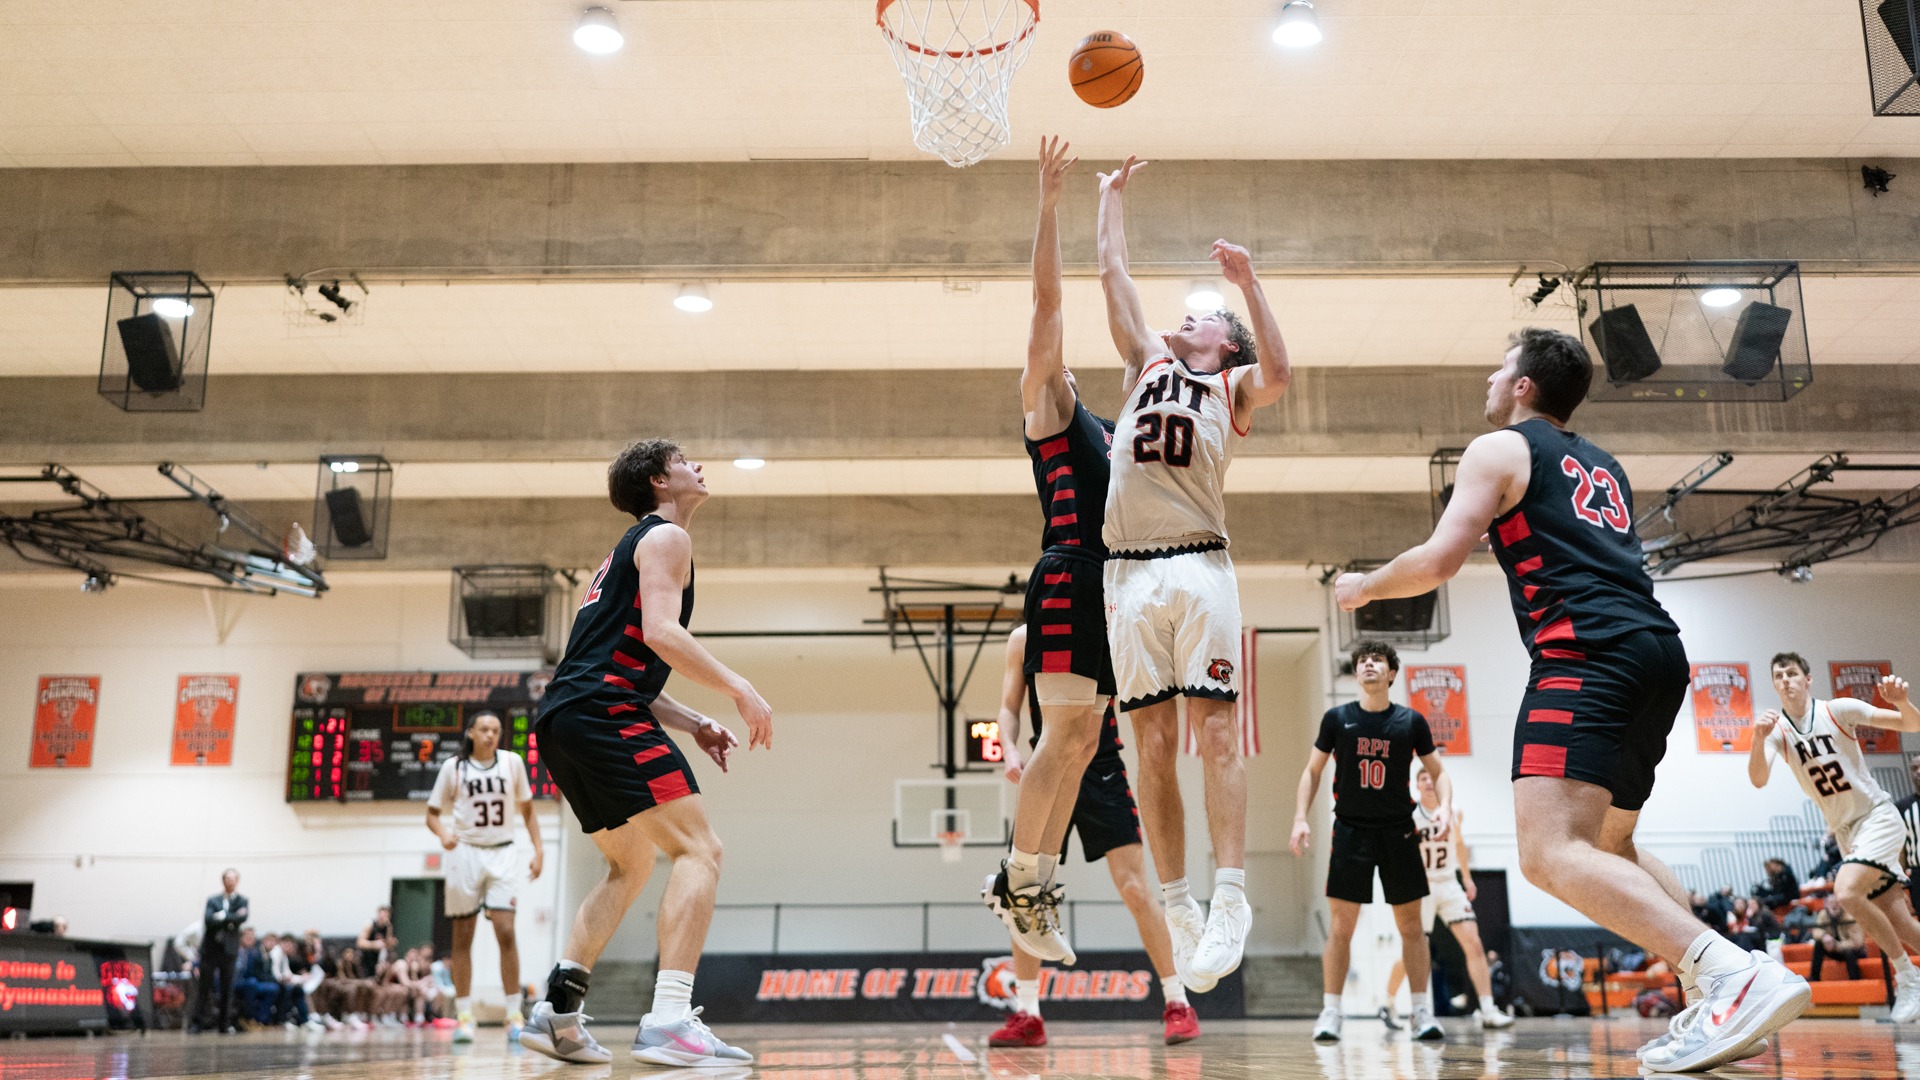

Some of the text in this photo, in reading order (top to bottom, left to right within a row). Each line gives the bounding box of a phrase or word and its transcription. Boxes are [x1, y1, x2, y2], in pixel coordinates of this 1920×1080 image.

[1133, 370, 1211, 415] RIT
[1133, 412, 1195, 468] 20
[1560, 454, 1632, 534] 23
[418, 739, 434, 763] 2
[1356, 737, 1391, 758] RPI
[1794, 734, 1838, 766] RIT
[467, 777, 507, 798] RIT
[1358, 759, 1386, 790] 10
[1808, 760, 1852, 796] 22
[473, 800, 504, 827] 33
[1425, 847, 1447, 869] 12
[55, 959, 76, 980] to
[755, 966, 1153, 1001] HOME OF THE TIGERS
